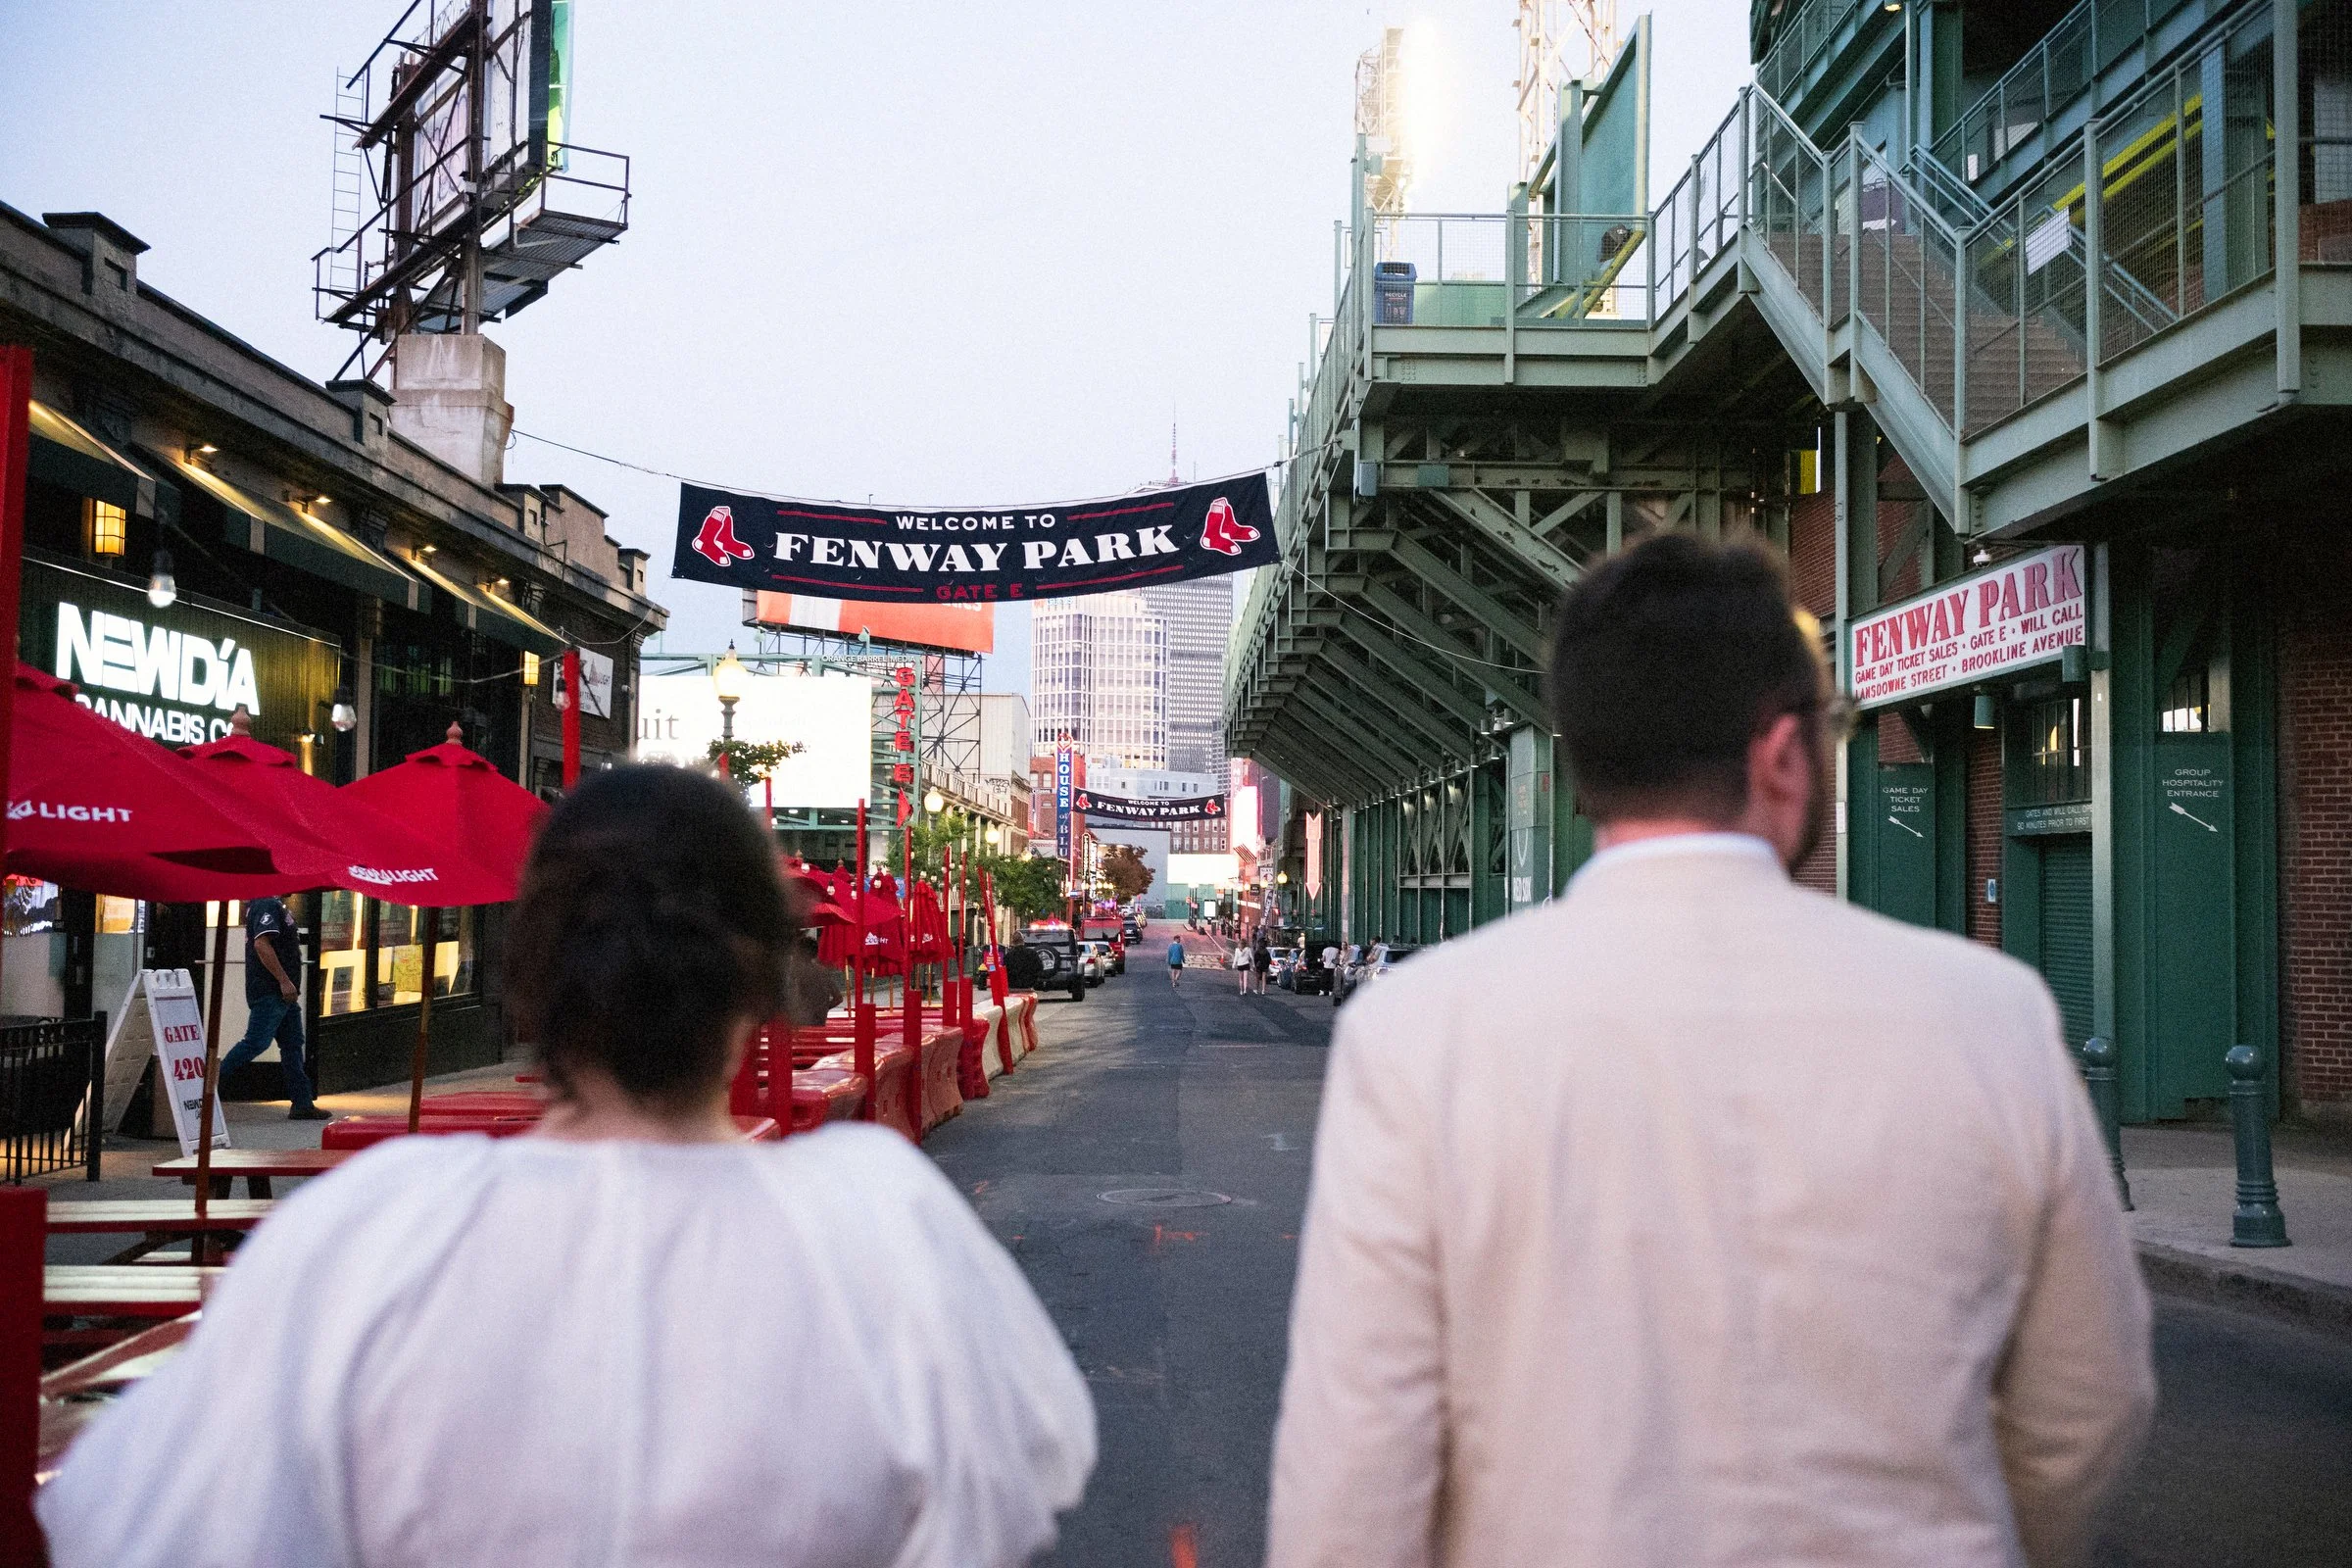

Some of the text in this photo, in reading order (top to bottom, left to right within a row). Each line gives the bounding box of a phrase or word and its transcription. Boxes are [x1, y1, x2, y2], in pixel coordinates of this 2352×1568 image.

[895, 513, 1055, 531] WELCOME TO
[773, 524, 1181, 573] FENWAY PARK
[935, 582, 1024, 600] GATE E
[1855, 548, 2082, 667] FENWAY PARK
[1855, 603, 2083, 684] GAME DAY TICKET SALES GATE E WILL CALL
[1855, 625, 2083, 700] LANSDOWNE STREET BROOKLINE AVENUE
[894, 668, 914, 752] GATE
[1058, 753, 1070, 808] HOUSE
[2167, 789, 2219, 798] ENTRANCE
[39, 802, 133, 822] LIGHT
[1097, 801, 1200, 816] FENWAY PARK
[389, 867, 439, 883] LIGHT
[165, 1025, 200, 1044] GATE
[174, 1056, 206, 1081] 420
